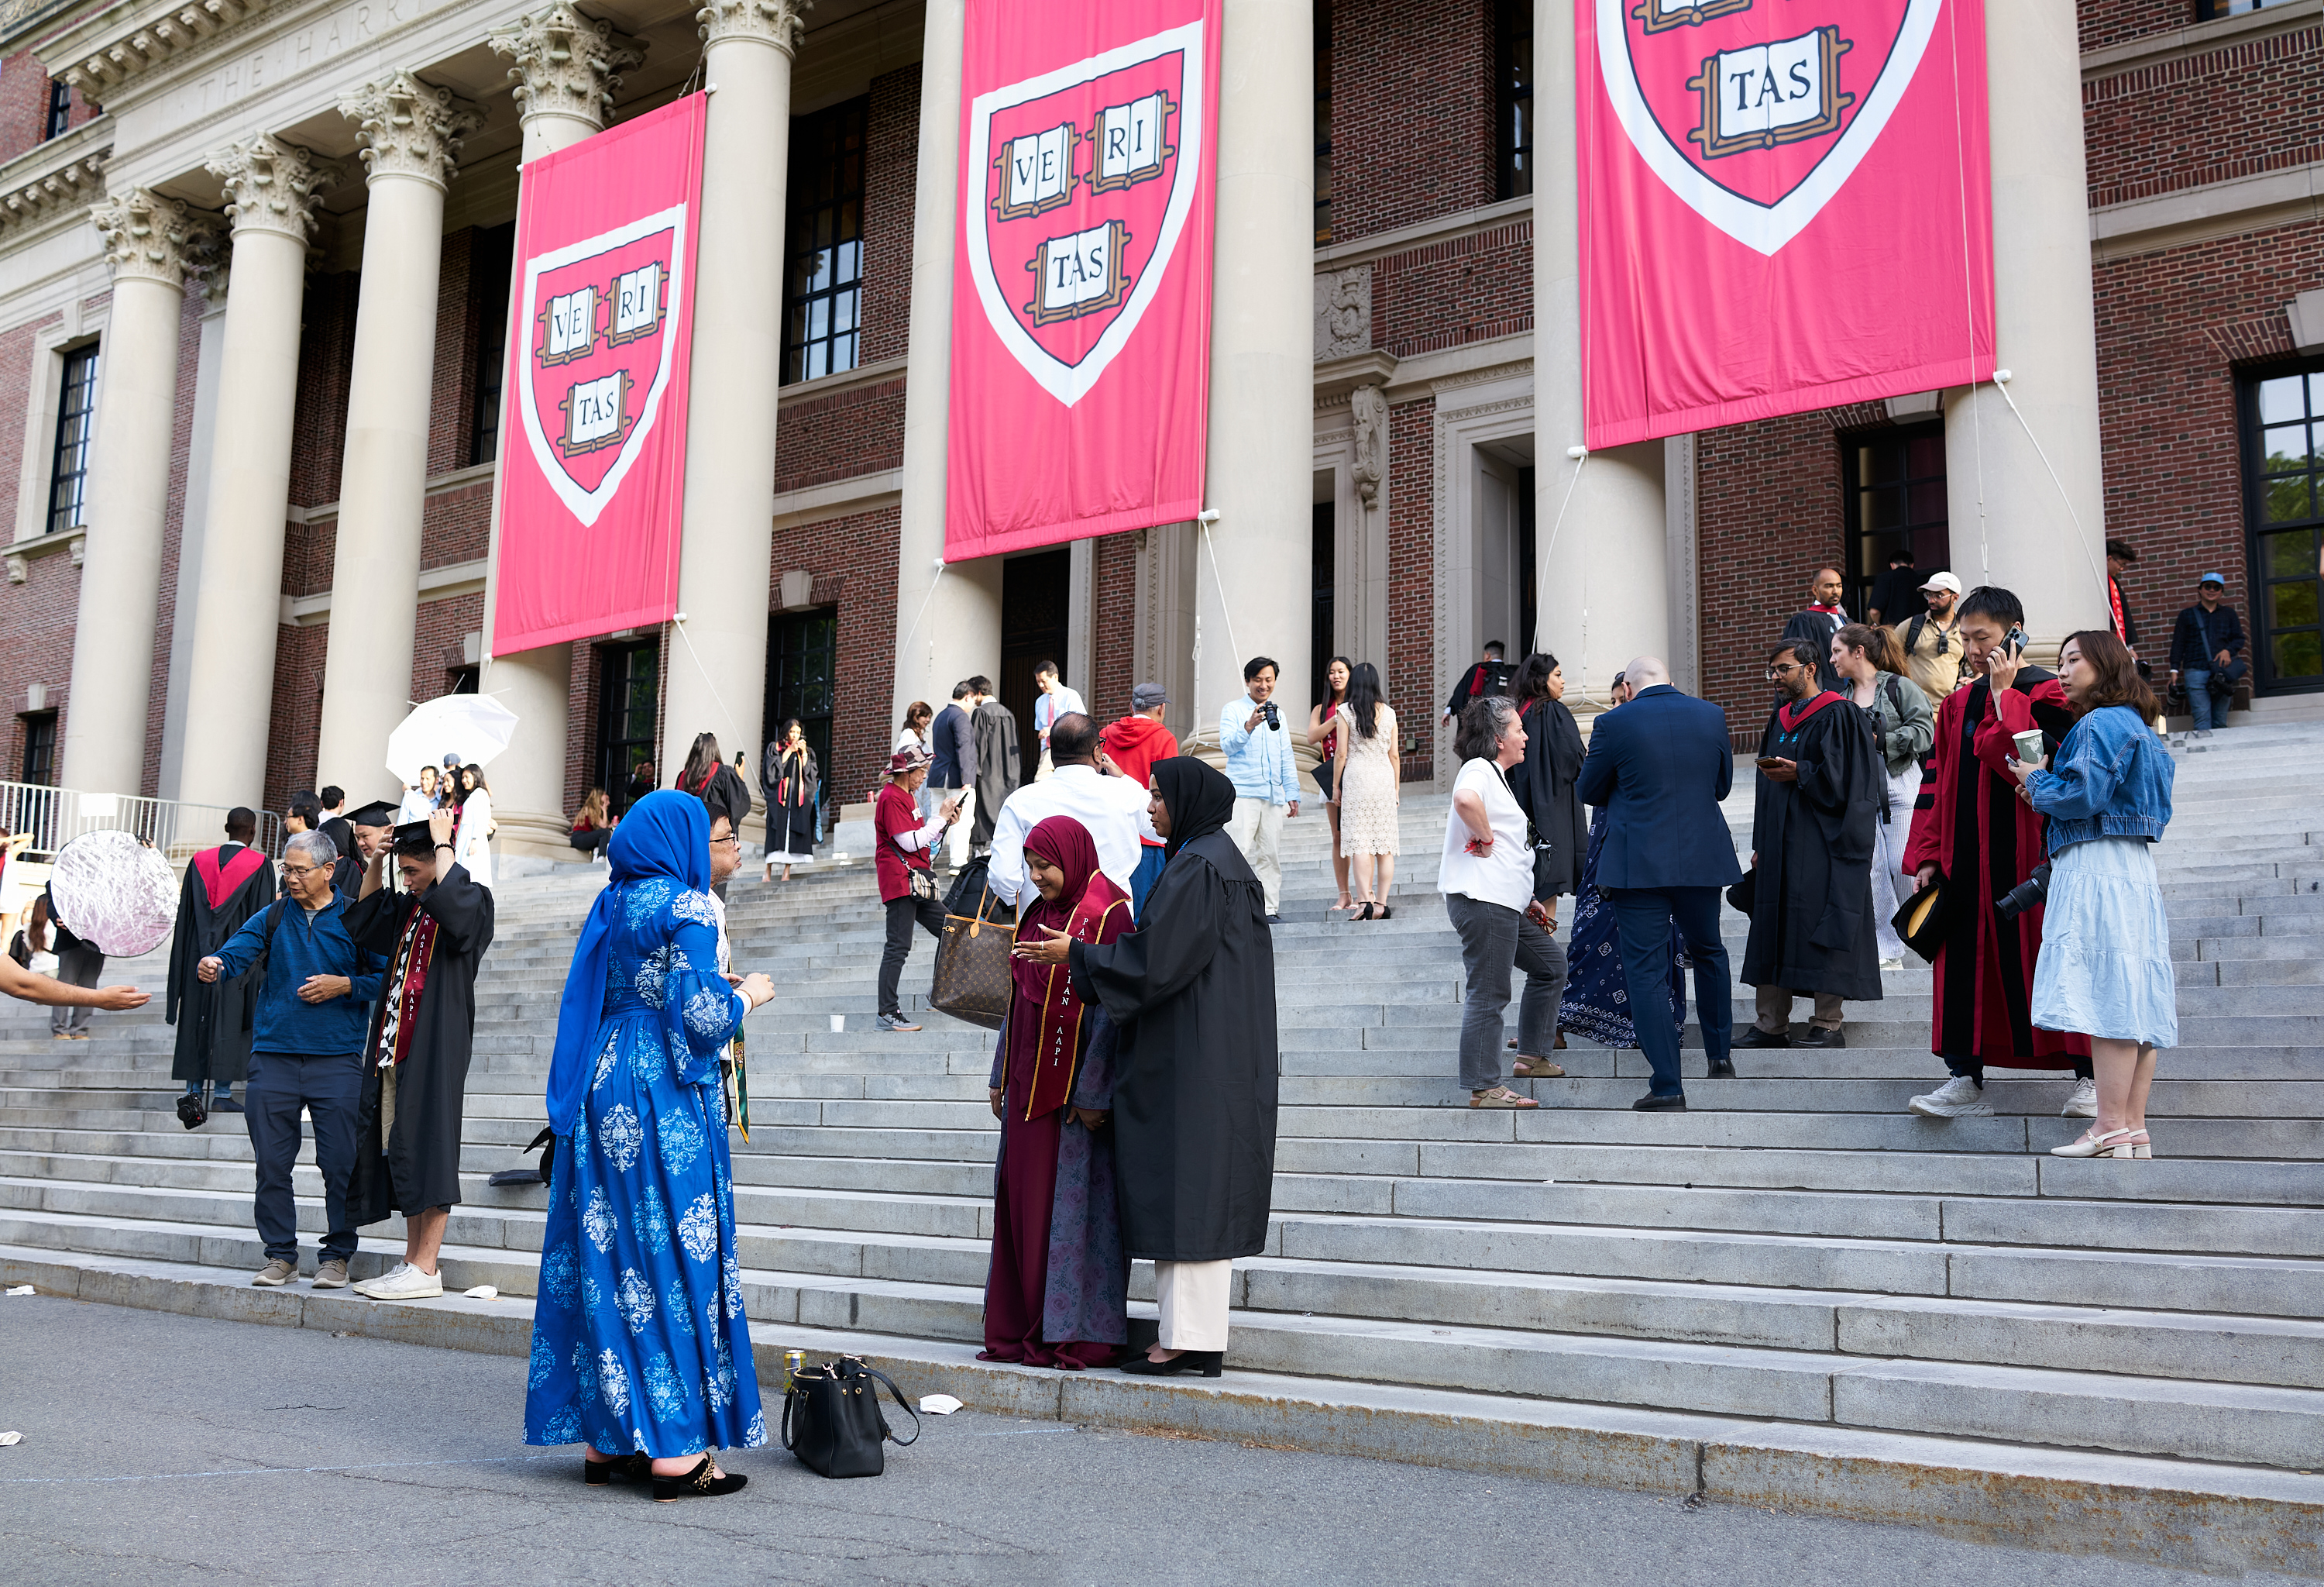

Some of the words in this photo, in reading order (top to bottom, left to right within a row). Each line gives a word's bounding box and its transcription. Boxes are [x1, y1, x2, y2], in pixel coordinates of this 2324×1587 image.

[198, 55, 263, 113] THE
[1729, 59, 1811, 111] TAS
[1015, 150, 1055, 186] VE
[1108, 119, 1143, 160] RI
[1052, 246, 1103, 288] TAS
[554, 308, 582, 339] VE
[620, 285, 646, 318] RI
[579, 391, 614, 426] TAS
[415, 933, 426, 973] ASIAN
[1054, 1025, 1064, 1067] AAPI
